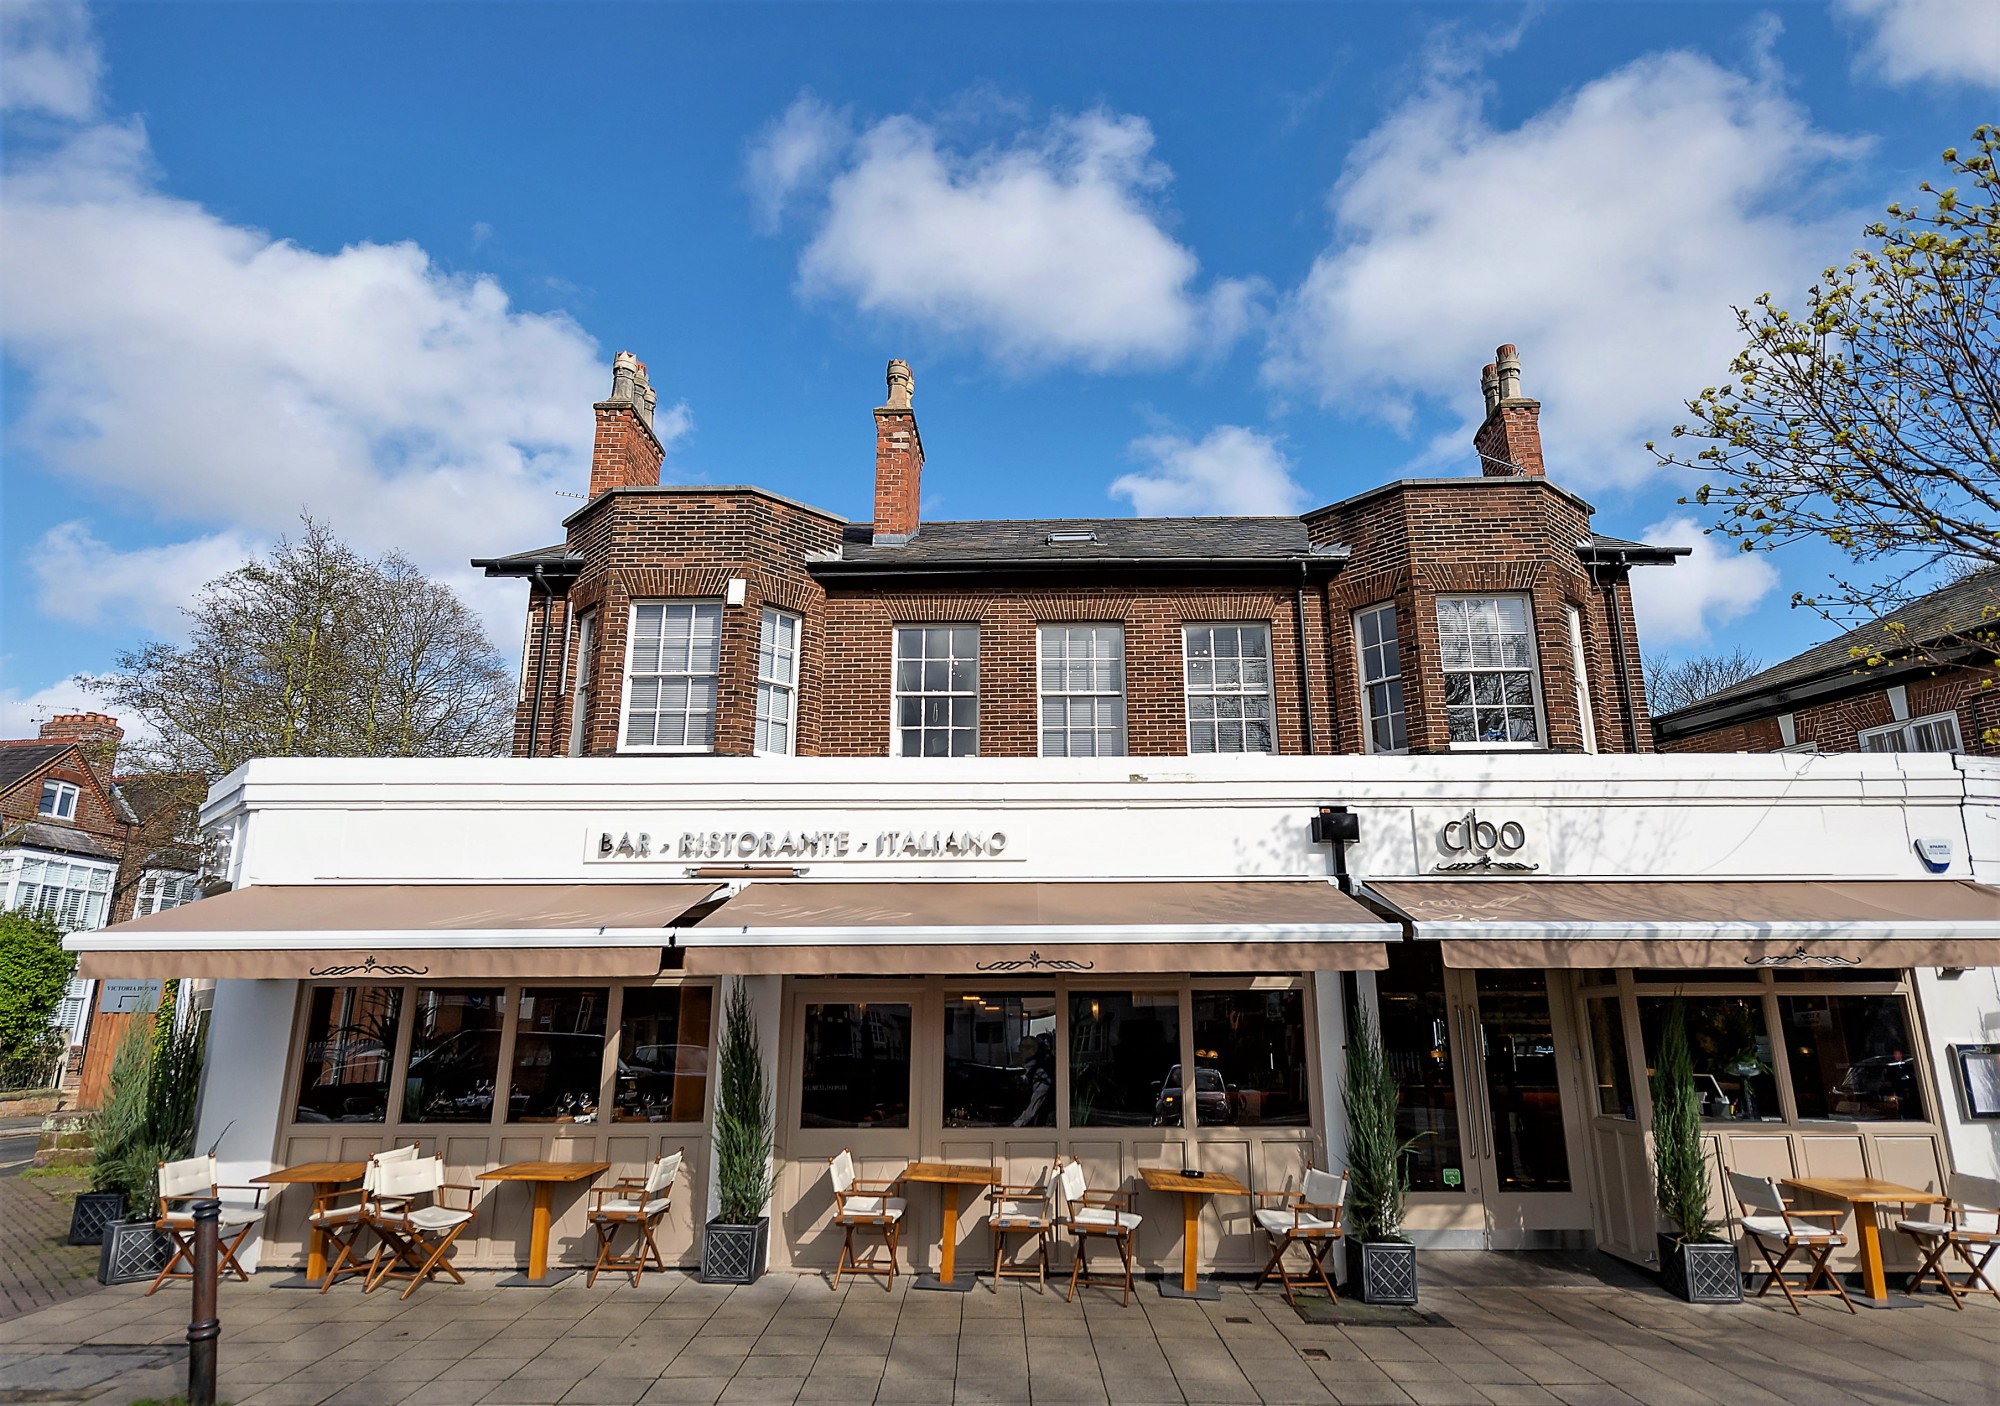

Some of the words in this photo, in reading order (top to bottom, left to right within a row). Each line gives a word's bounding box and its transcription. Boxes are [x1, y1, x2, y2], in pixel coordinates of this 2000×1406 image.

[600, 832, 652, 853] BAR
[681, 830, 850, 853] RISTORANTE
[880, 830, 1009, 853] ITALIANO
[1443, 808, 1525, 850] cibo
